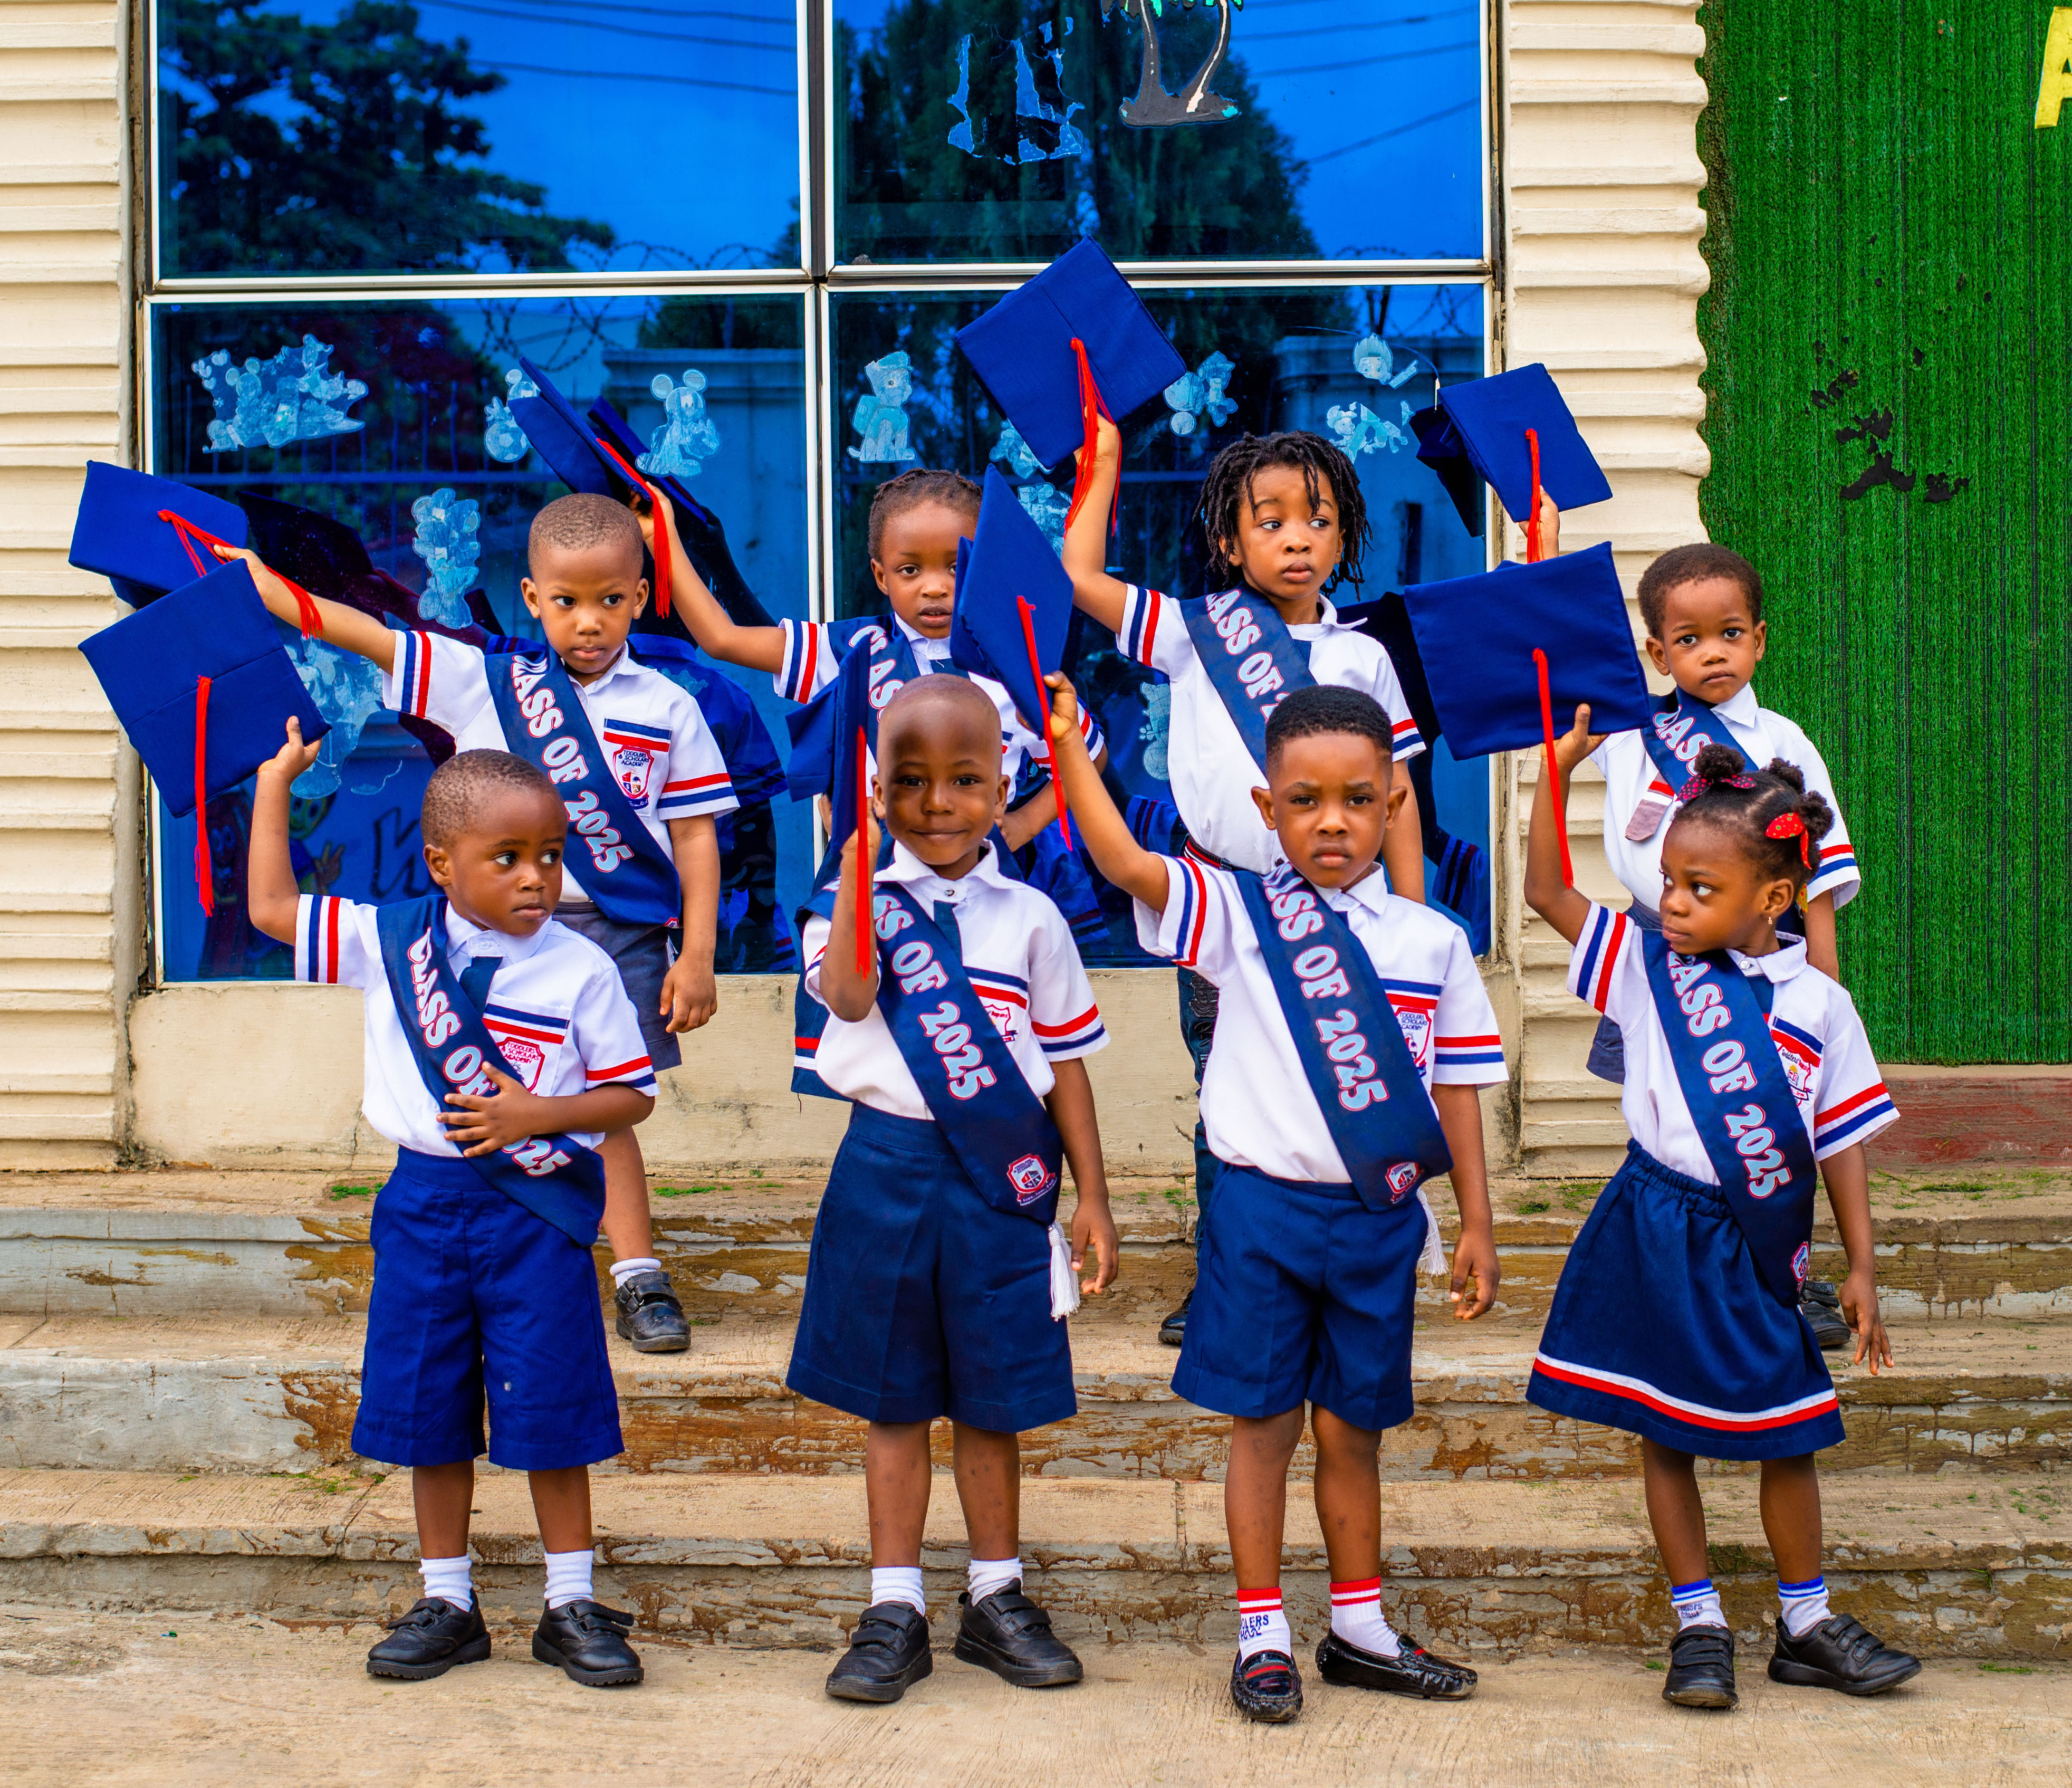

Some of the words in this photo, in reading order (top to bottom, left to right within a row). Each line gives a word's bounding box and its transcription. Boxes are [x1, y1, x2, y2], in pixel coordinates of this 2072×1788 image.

[1238, 652, 1284, 699] OF
[542, 737, 589, 785] OF
[564, 790, 634, 873] 2025
[891, 941, 948, 995] OF
[1293, 945, 1351, 998] OF
[507, 1042, 535, 1054] TODDLERS
[508, 1048, 539, 1060] SCHOLARS
[918, 1001, 997, 1100] 2025
[1316, 1009, 1389, 1111] 2025
[1702, 1040, 1757, 1093] OF
[502, 1136, 572, 1177] 25
[1723, 1104, 1792, 1199] 2025
